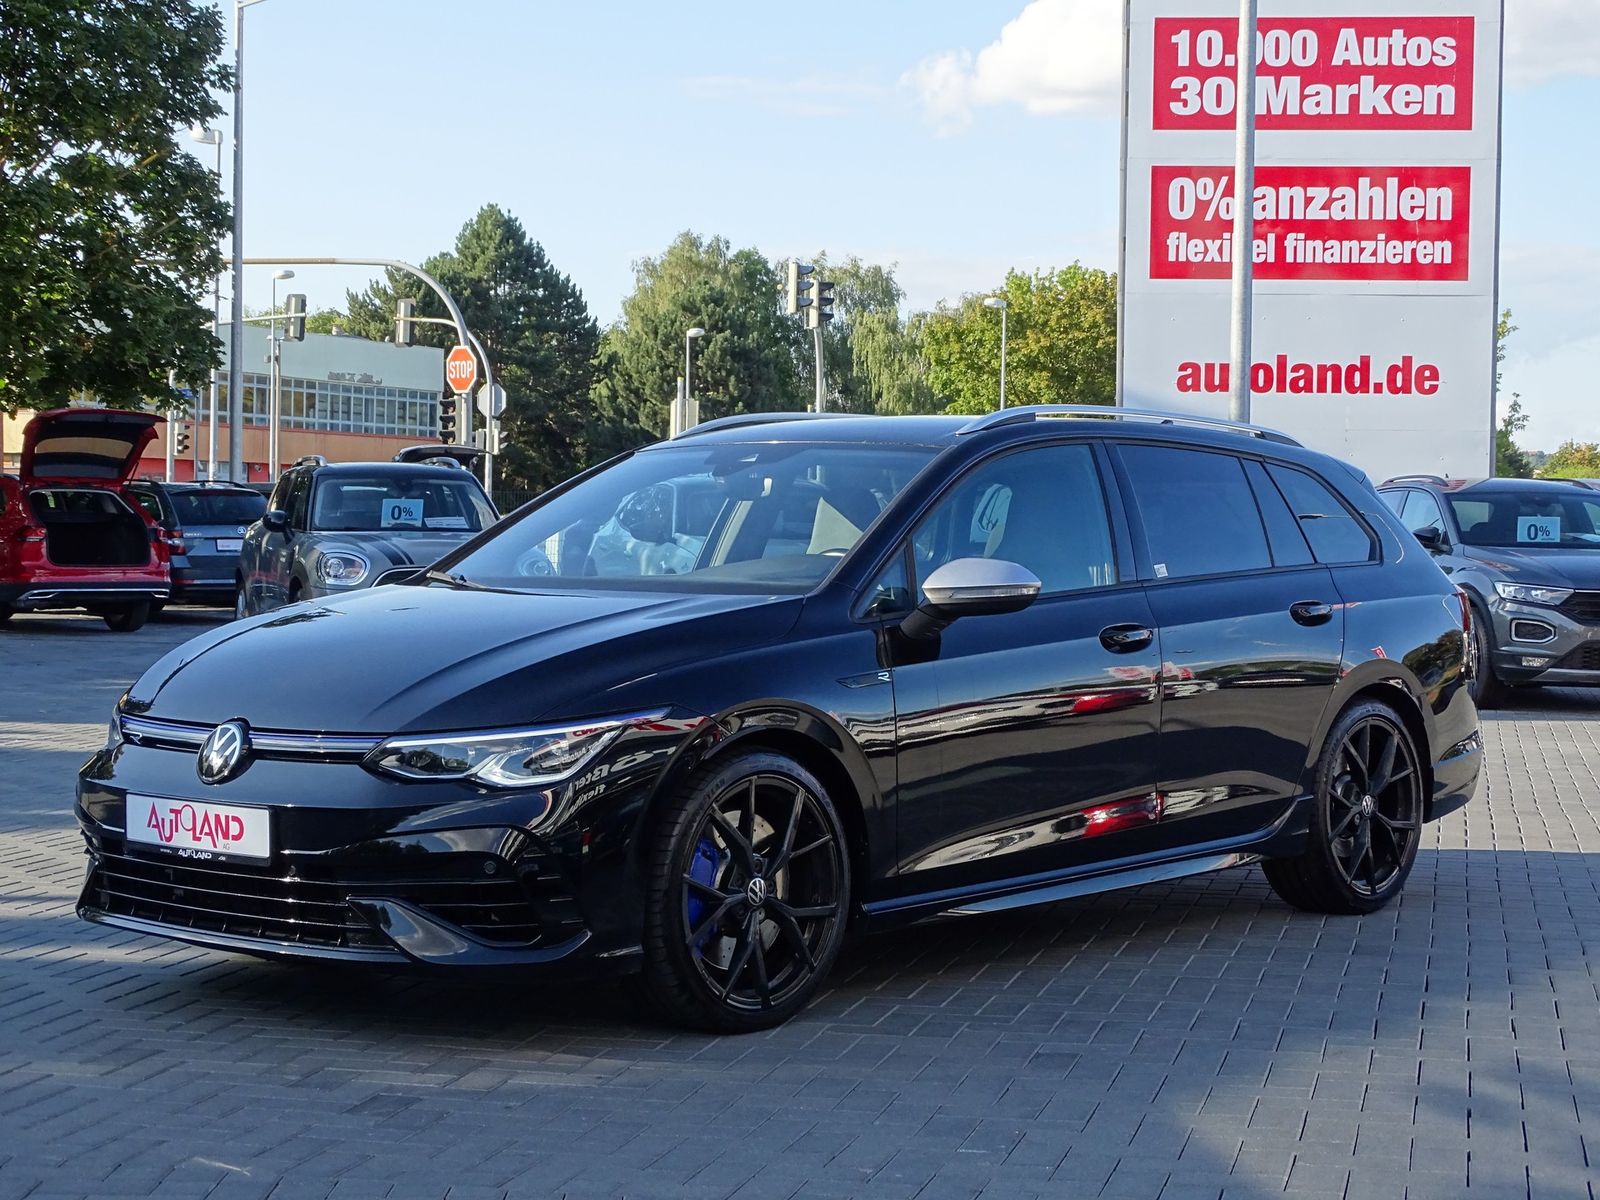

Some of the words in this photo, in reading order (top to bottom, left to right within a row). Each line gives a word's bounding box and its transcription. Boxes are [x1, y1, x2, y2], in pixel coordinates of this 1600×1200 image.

[1171, 29, 1318, 67] 10.00
[1332, 28, 1457, 67] Autos
[1168, 76, 1236, 116] 30
[1254, 75, 1456, 116] Marken
[1168, 176, 1235, 221] 0%
[1253, 177, 1452, 221] anzahlen
[1167, 232, 1275, 263] flexiel
[1284, 232, 1452, 264] finanzieren
[449, 361, 473, 379] STOP
[1176, 354, 1440, 395] auoland.de
[391, 505, 414, 520] 0%
[1527, 523, 1551, 540] 0%
